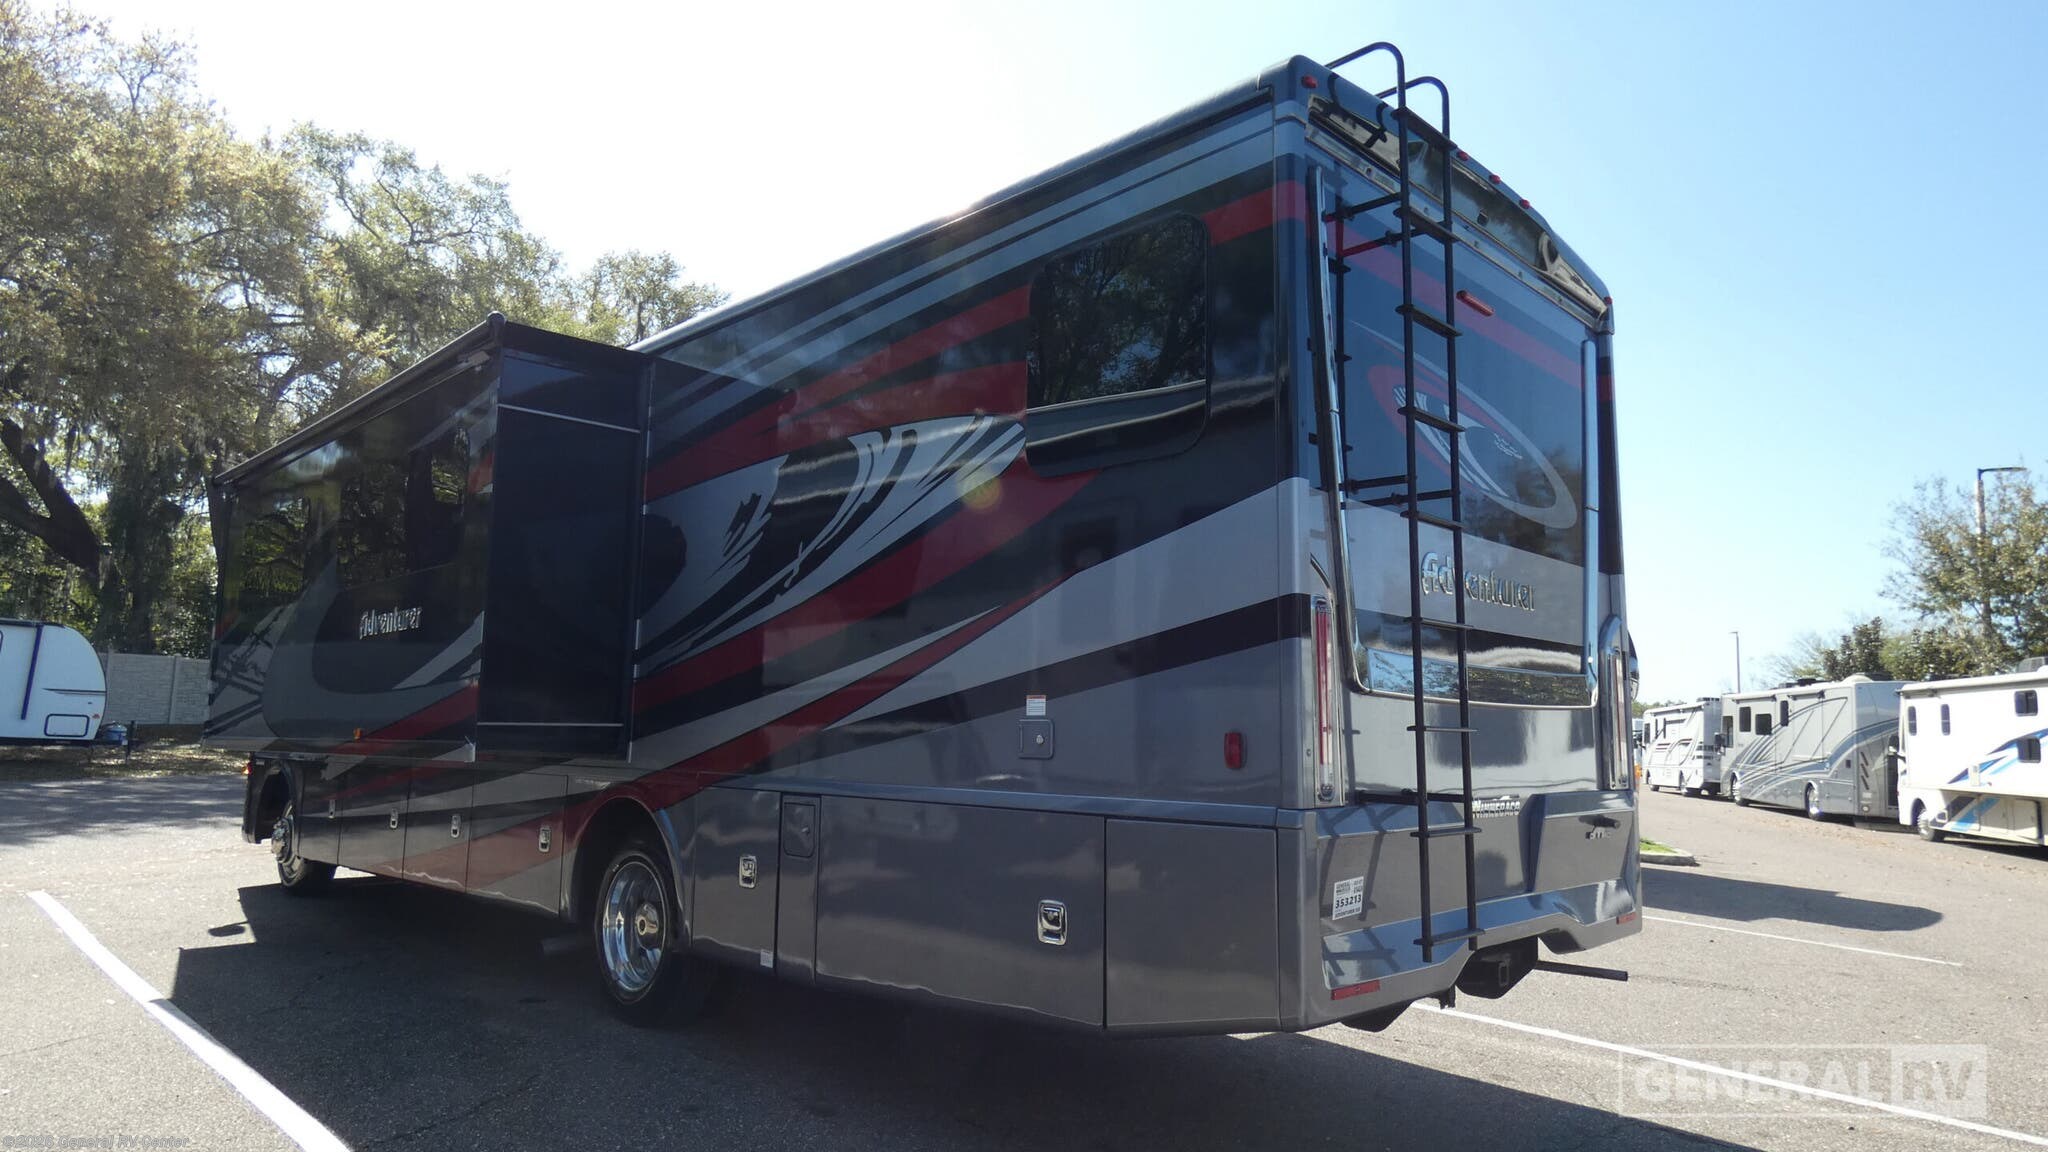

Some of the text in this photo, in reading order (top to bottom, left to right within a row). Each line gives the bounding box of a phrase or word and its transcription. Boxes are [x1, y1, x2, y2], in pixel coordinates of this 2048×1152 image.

[1421, 551, 1536, 612] Adenturer
[359, 606, 422, 640] Adventurer
[1335, 894, 1362, 909] 353213
